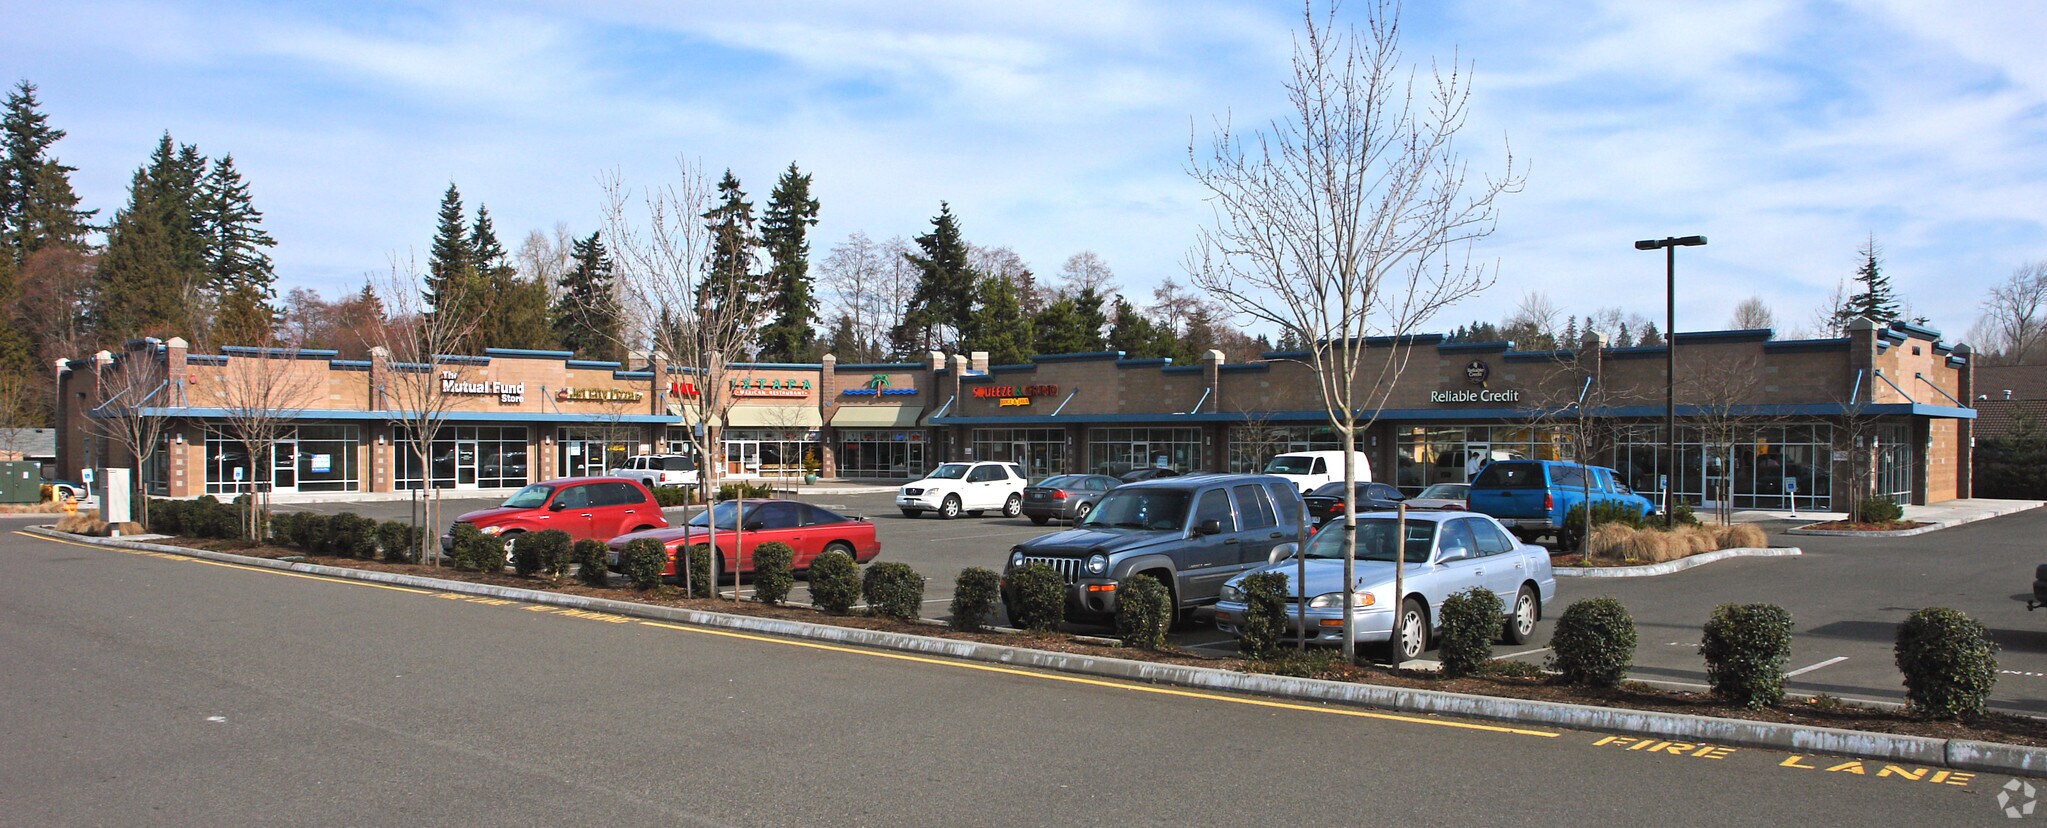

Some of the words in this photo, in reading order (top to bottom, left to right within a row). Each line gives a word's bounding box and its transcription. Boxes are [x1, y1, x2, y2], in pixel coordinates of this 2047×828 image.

[442, 379, 489, 393] Mutual
[492, 381, 525, 394] Fund
[731, 377, 811, 389] IXTAPA
[501, 393, 525, 403] Store
[972, 386, 1012, 398] SQUEEZE
[1015, 385, 1022, 397] &
[1025, 384, 1058, 397] GRIND
[1430, 390, 1478, 403] Reliable
[1480, 389, 1519, 402] Credit
[1592, 735, 1738, 760] FIRE
[1778, 754, 1976, 787] LANE
